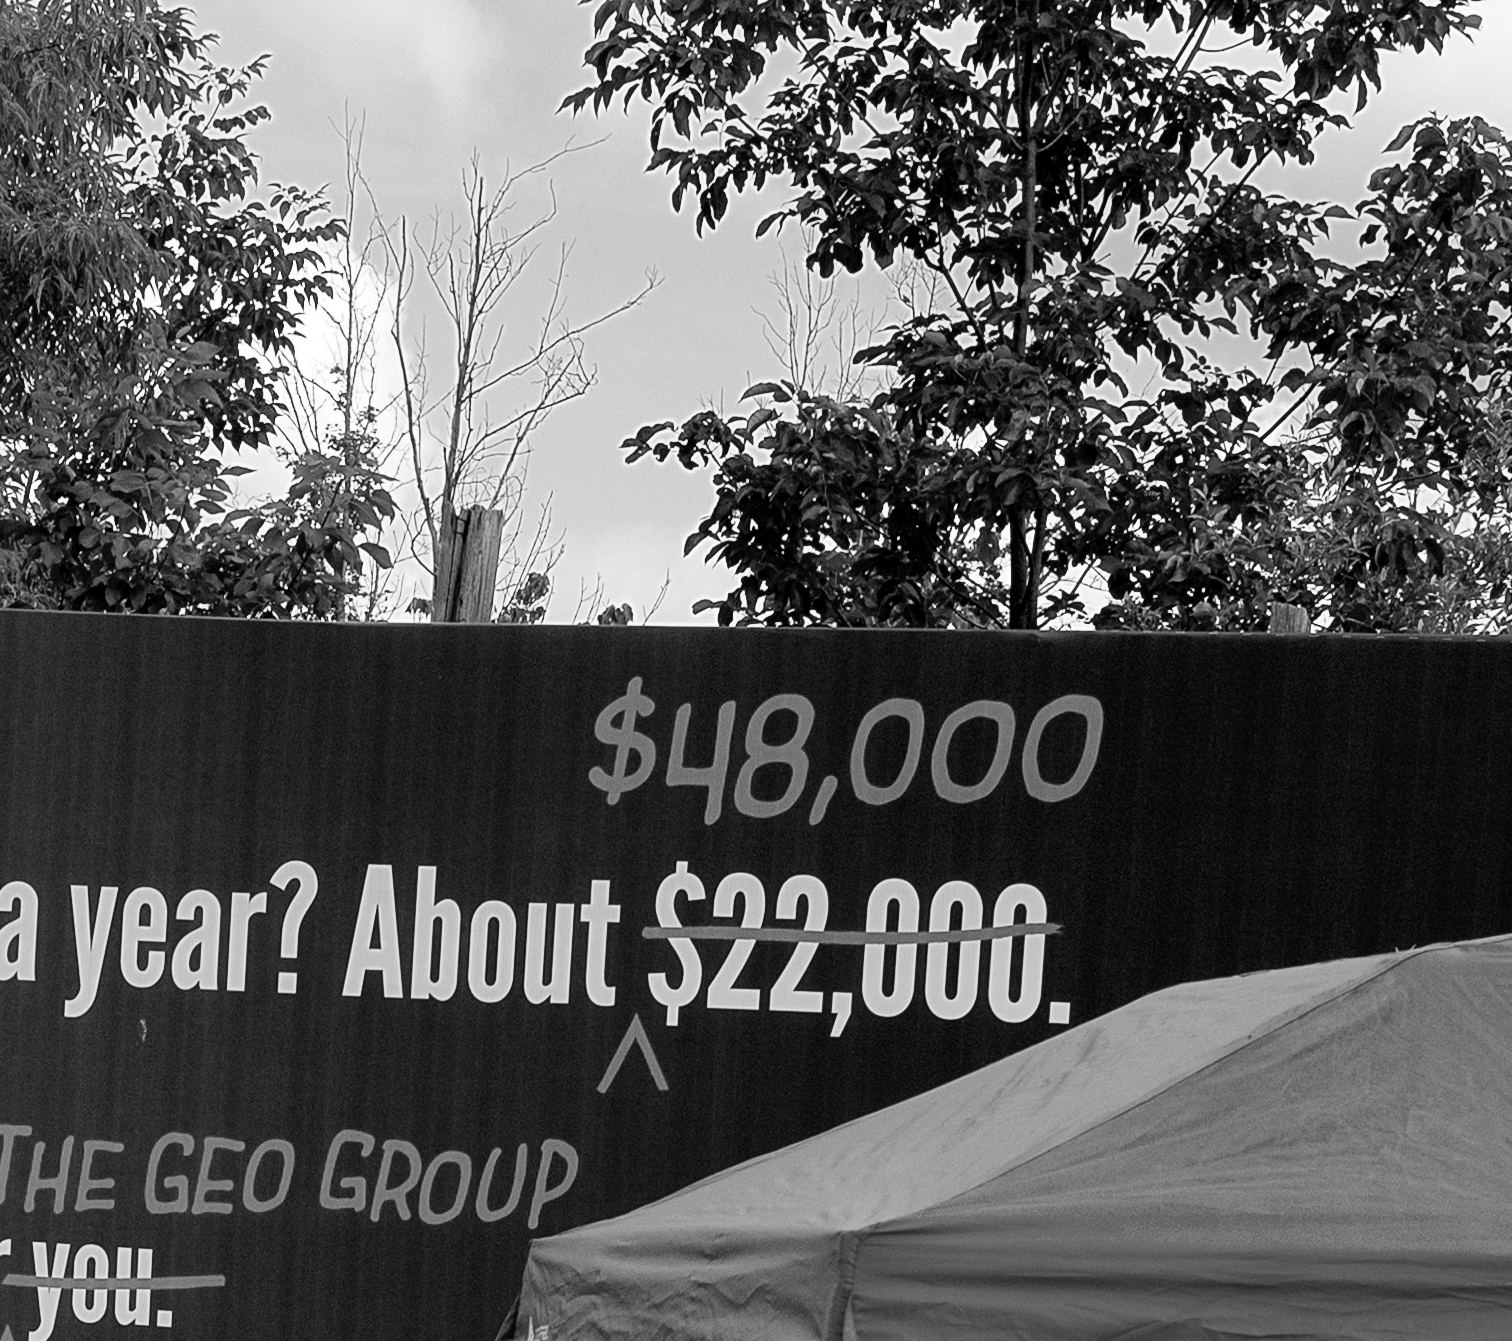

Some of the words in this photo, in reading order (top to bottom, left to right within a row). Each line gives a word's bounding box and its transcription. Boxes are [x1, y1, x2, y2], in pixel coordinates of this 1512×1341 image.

[588, 676, 1104, 826] $48,000
[65, 860, 318, 1018] year?
[342, 864, 620, 1006] About
[648, 861, 1071, 1037] $22,000.
[145, 1132, 295, 1215] GEO
[320, 1129, 579, 1230] GROUP
